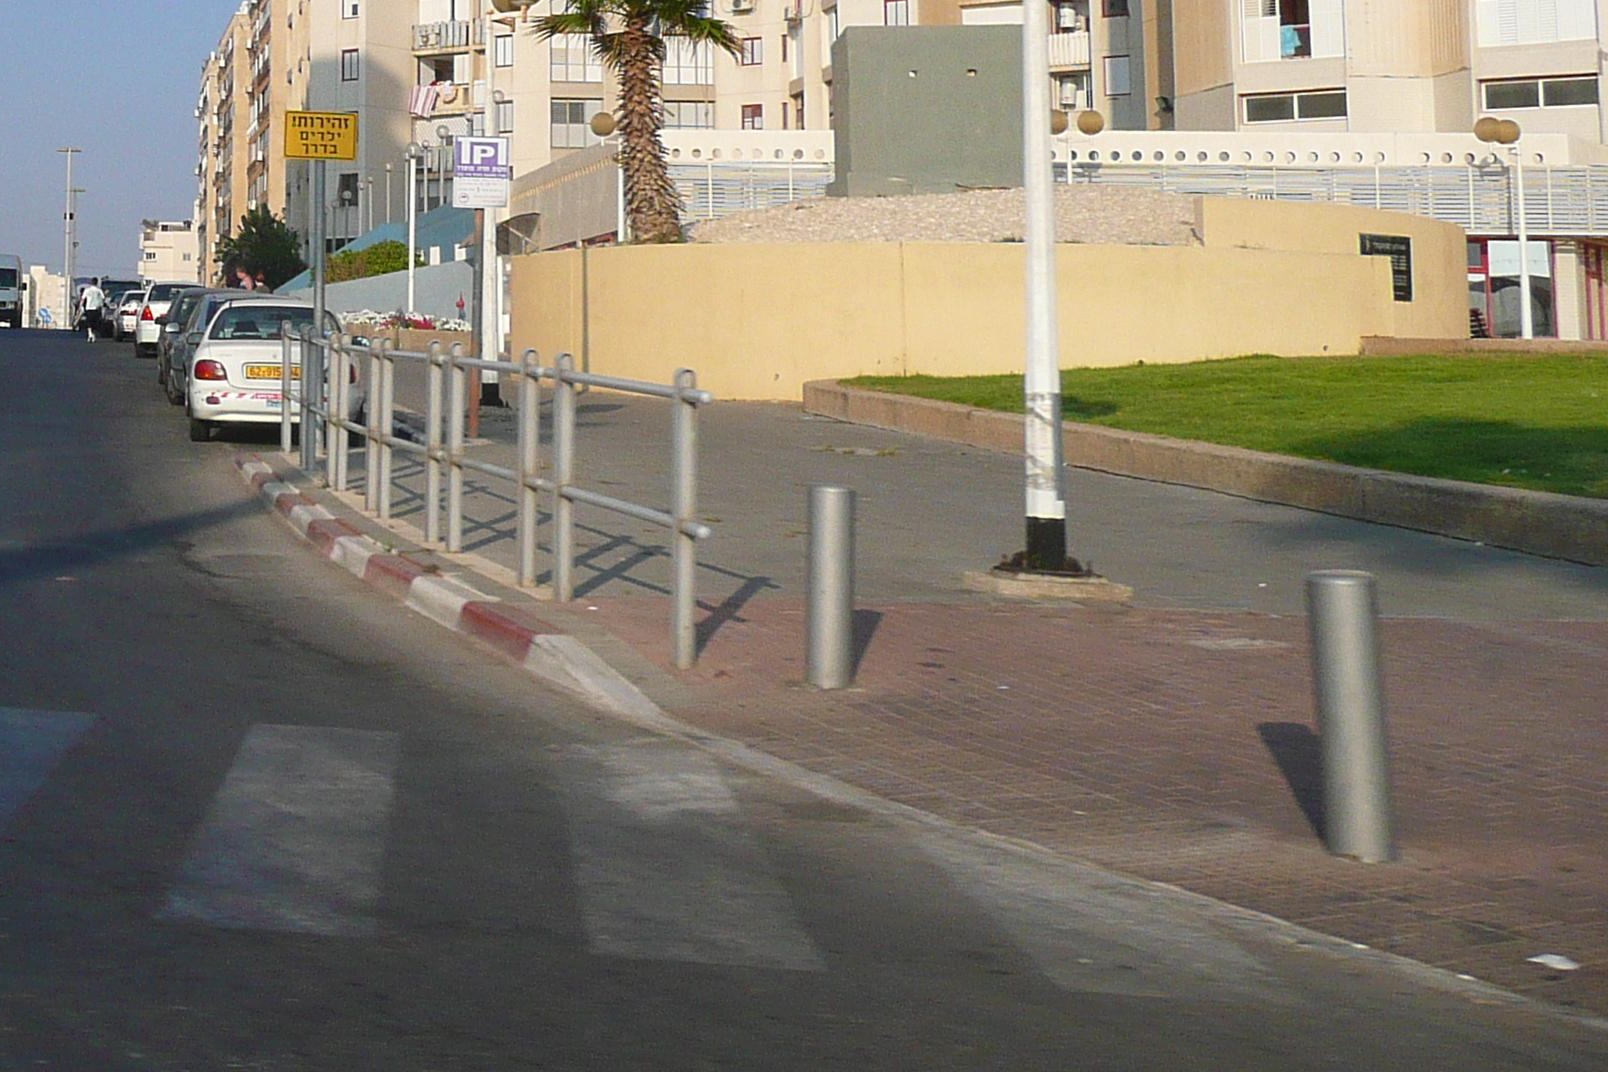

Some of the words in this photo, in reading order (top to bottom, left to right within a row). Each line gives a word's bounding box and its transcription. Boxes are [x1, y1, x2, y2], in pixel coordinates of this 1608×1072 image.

[292, 116, 350, 129] זהירות!
[300, 131, 341, 141] ילדים
[302, 143, 338, 154] בדרך
